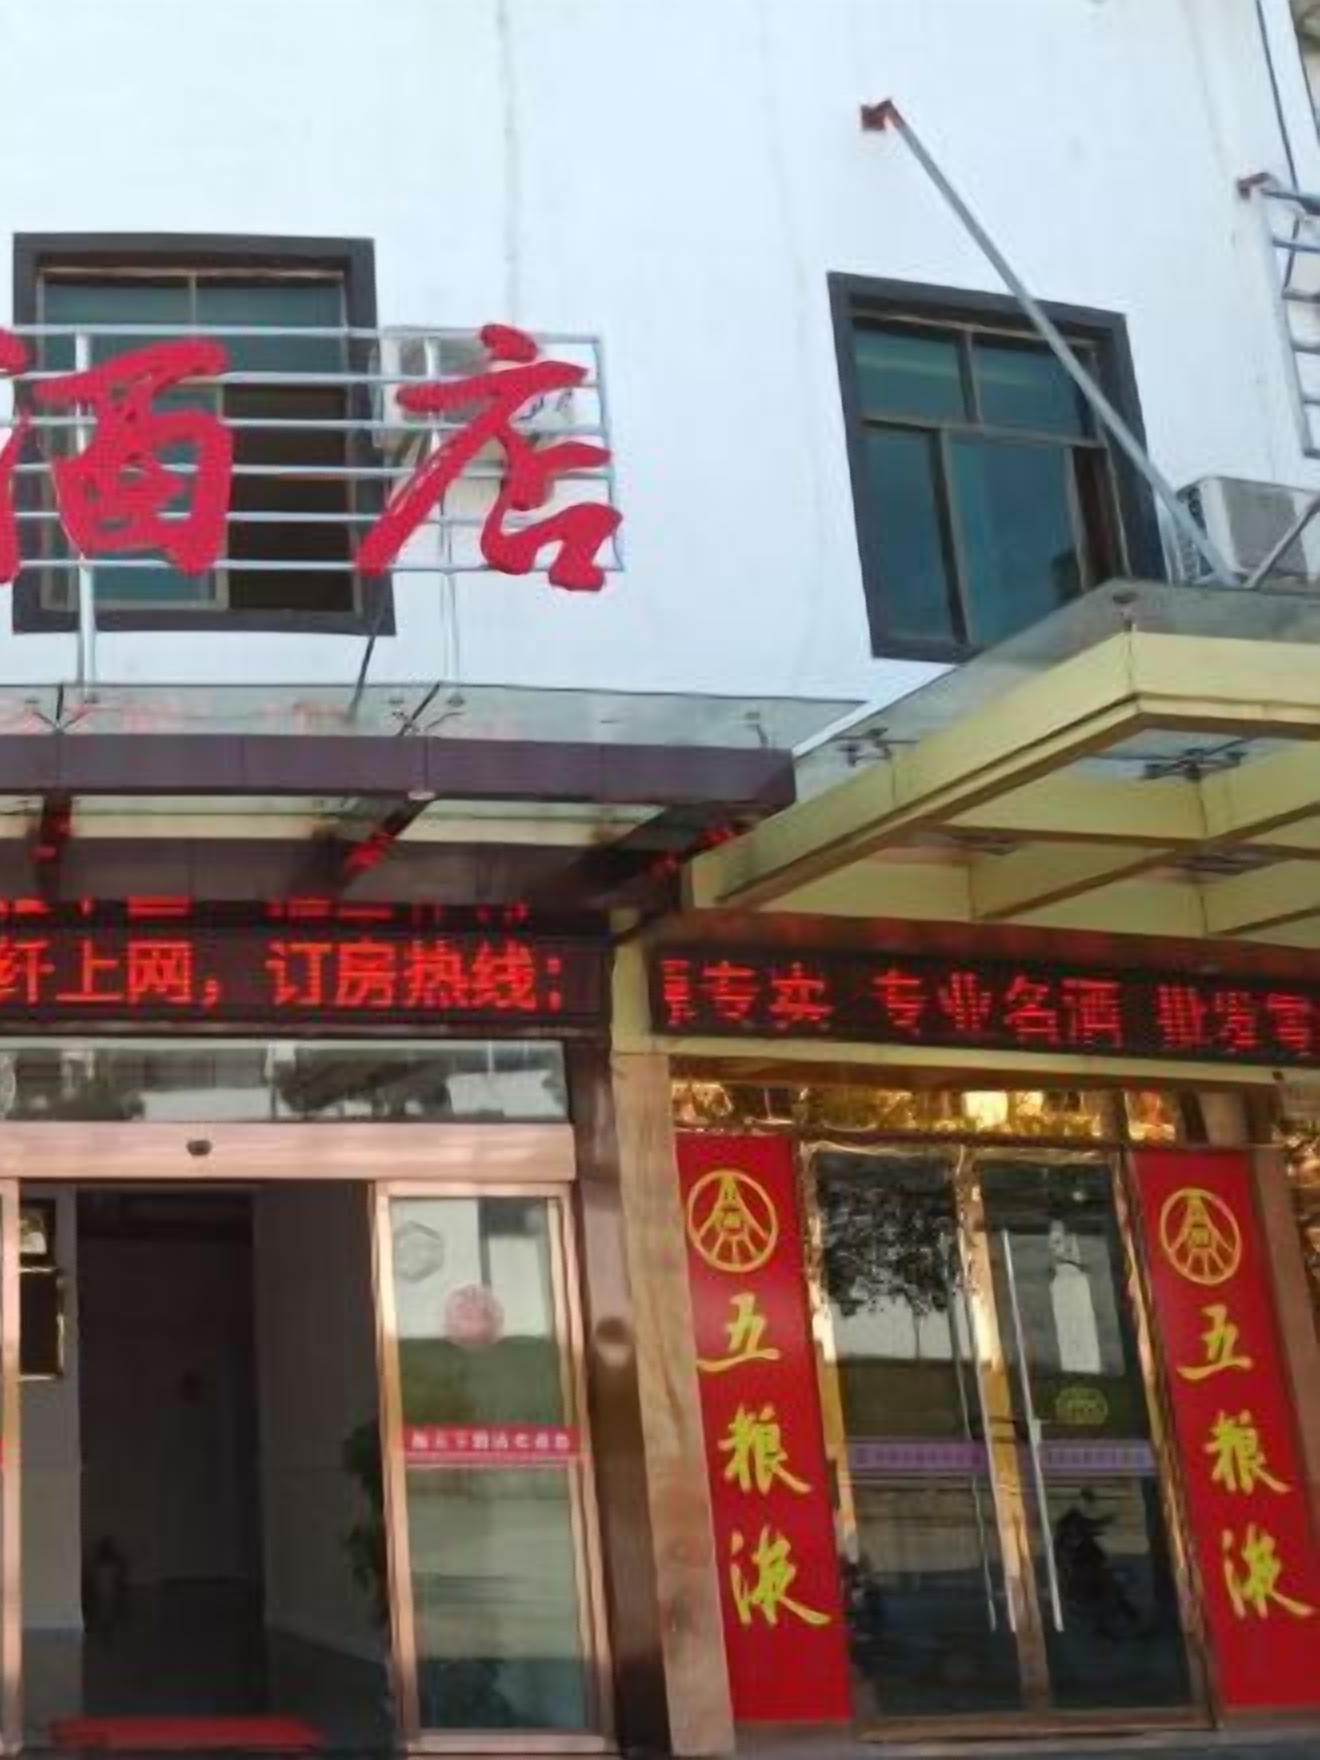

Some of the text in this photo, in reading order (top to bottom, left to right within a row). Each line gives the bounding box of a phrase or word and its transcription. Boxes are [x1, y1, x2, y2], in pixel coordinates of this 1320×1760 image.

[696, 1293, 831, 1626] 五粮液
[1176, 1304, 1315, 1619] 五粮液
